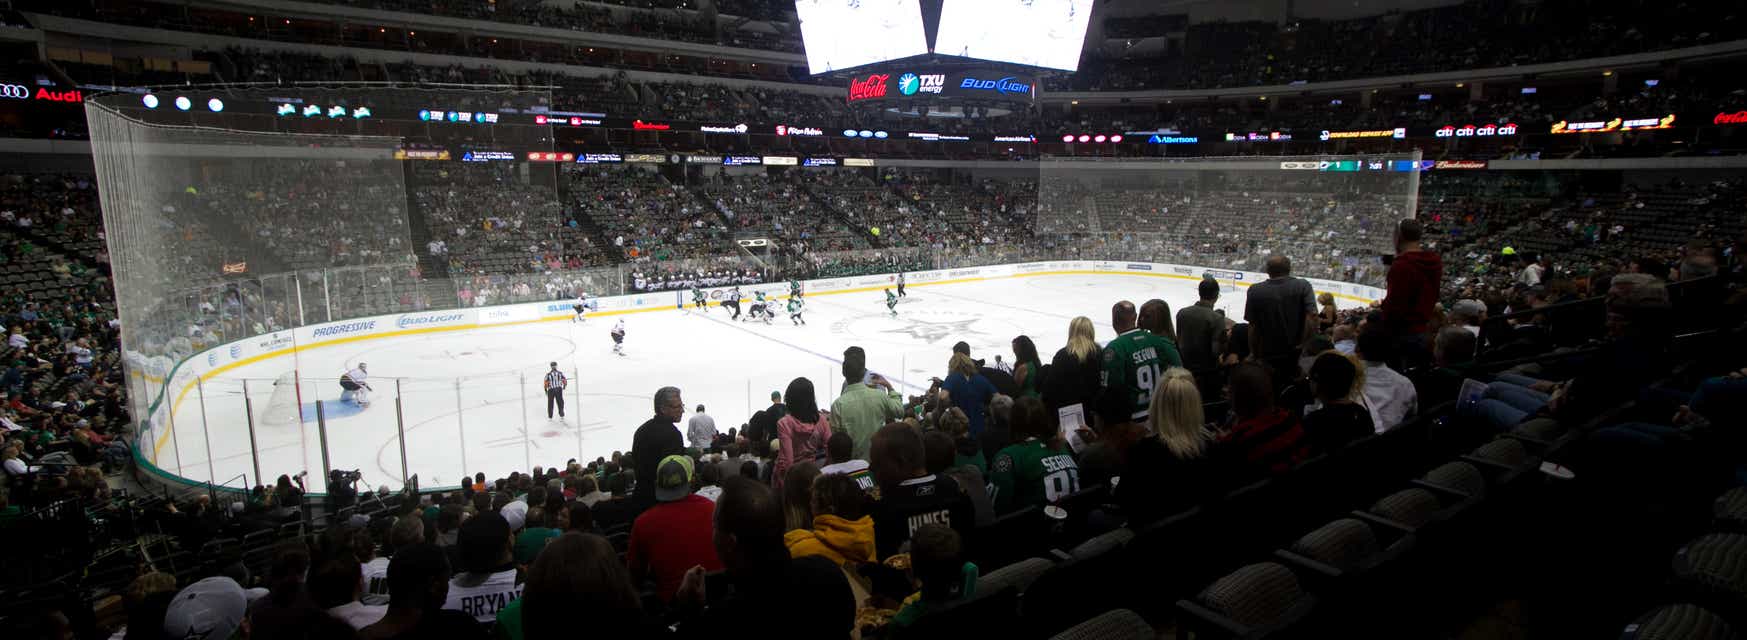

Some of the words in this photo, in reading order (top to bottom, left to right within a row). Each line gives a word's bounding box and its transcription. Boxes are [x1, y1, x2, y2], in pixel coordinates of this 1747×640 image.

[919, 74, 945, 87] TXU
[960, 78, 996, 88] BUD
[1001, 80, 1030, 93] LIGHT
[36, 87, 82, 103] Audi
[1435, 126, 1454, 137] citi
[1456, 126, 1474, 136] citi
[1476, 125, 1495, 135] citi
[1497, 124, 1516, 135] citi
[400, 317, 428, 326] BUD
[428, 313, 464, 323] LIGHT
[313, 320, 376, 338] PROGRESSIVE
[1041, 455, 1078, 472] SEGUIN
[907, 509, 951, 538] HINES
